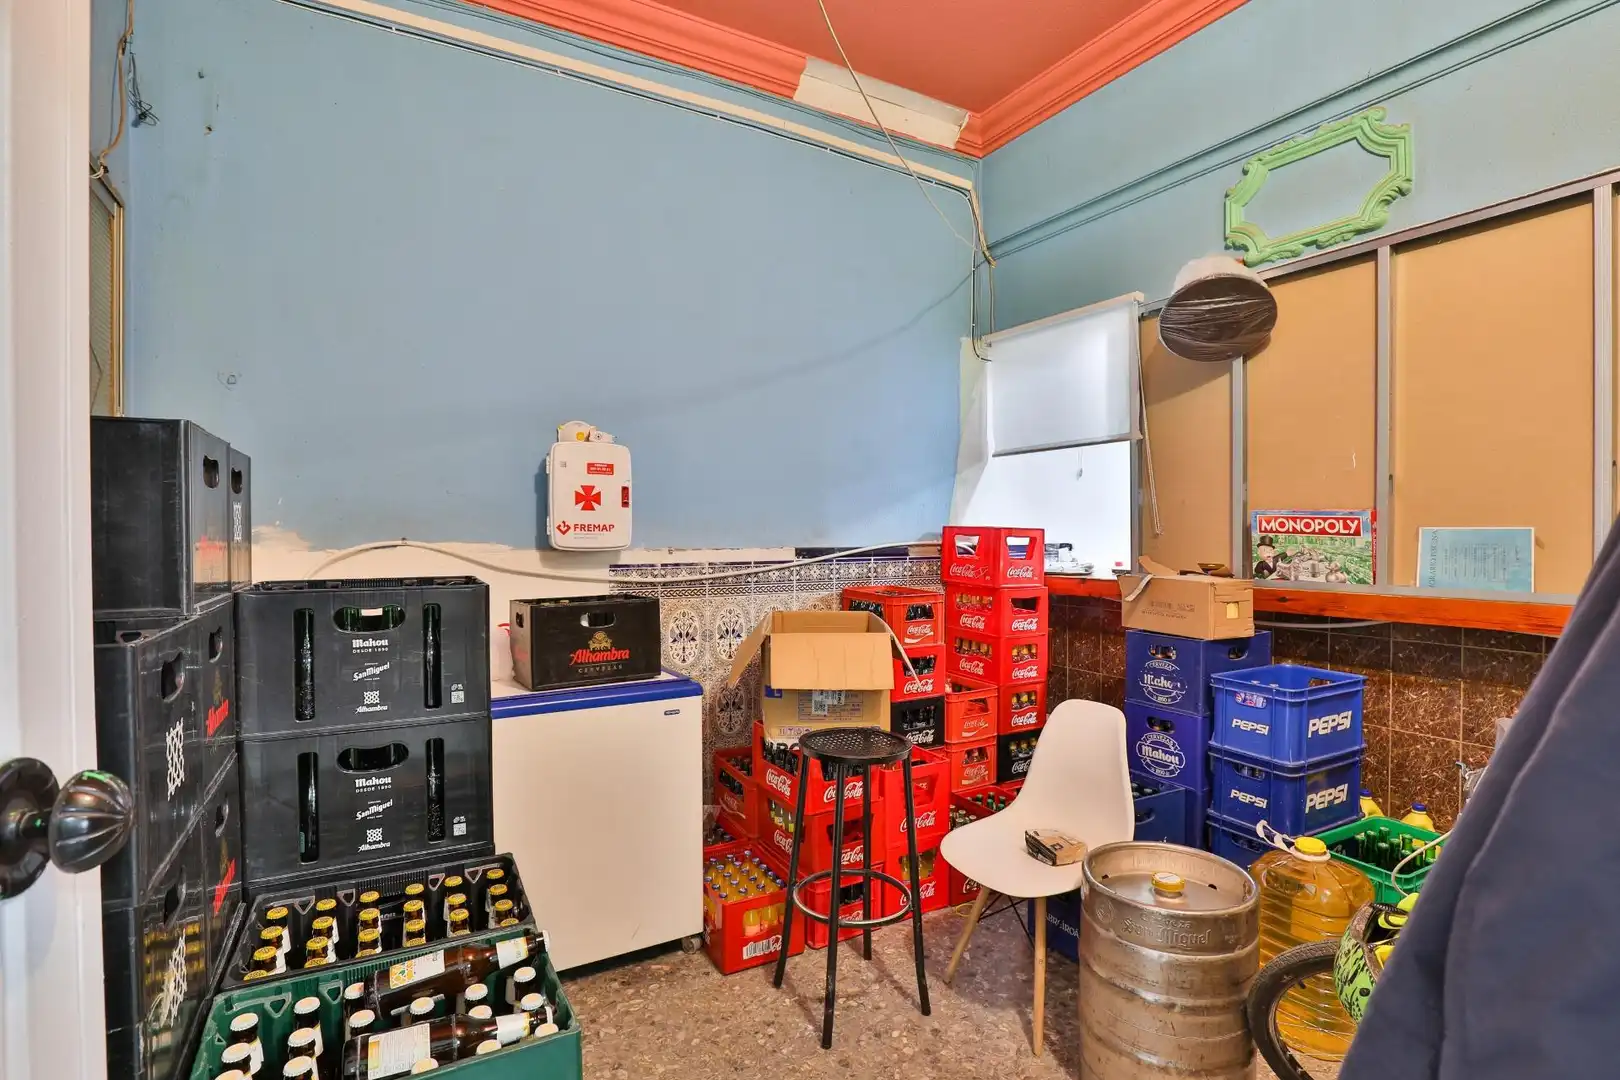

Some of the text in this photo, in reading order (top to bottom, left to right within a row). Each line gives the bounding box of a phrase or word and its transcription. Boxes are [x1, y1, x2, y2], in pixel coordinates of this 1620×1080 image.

[573, 523, 615, 532] FREMAP
[1261, 518, 1359, 534] MONOPOLY
[352, 638, 389, 648] Mahou
[569, 647, 630, 666] Alhambra
[1231, 718, 1270, 736] PEPSI
[1308, 710, 1352, 738] PEPSI
[1141, 744, 1180, 765] Mahou
[355, 776, 392, 788] Mahou
[1230, 789, 1268, 809] PEPSI
[1305, 783, 1349, 814] PEPSI
